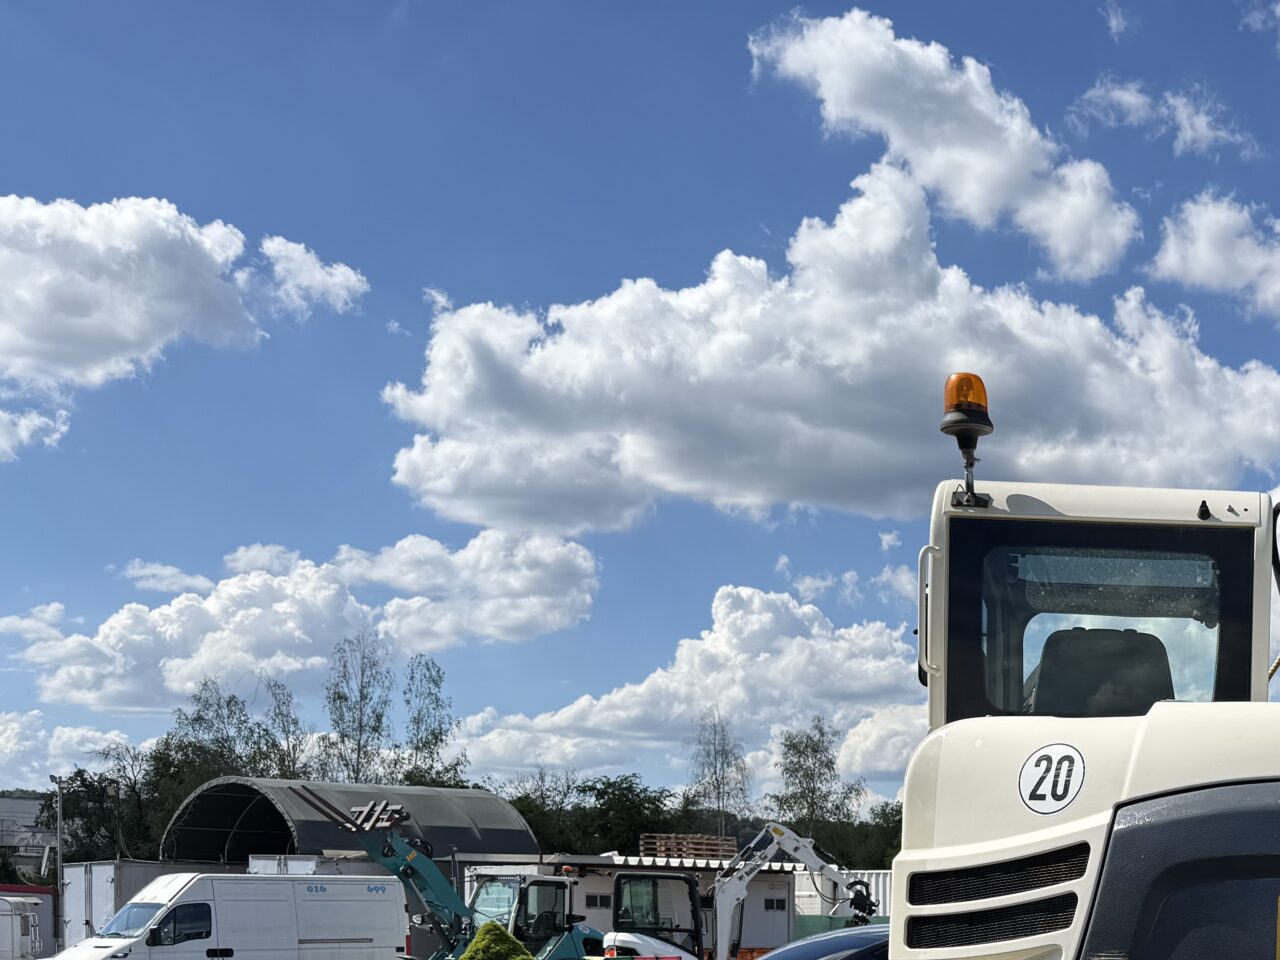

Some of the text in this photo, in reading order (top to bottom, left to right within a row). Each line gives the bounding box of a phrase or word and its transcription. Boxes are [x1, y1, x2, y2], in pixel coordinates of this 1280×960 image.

[1028, 754, 1075, 802] 20
[306, 885, 386, 893] 016 699
